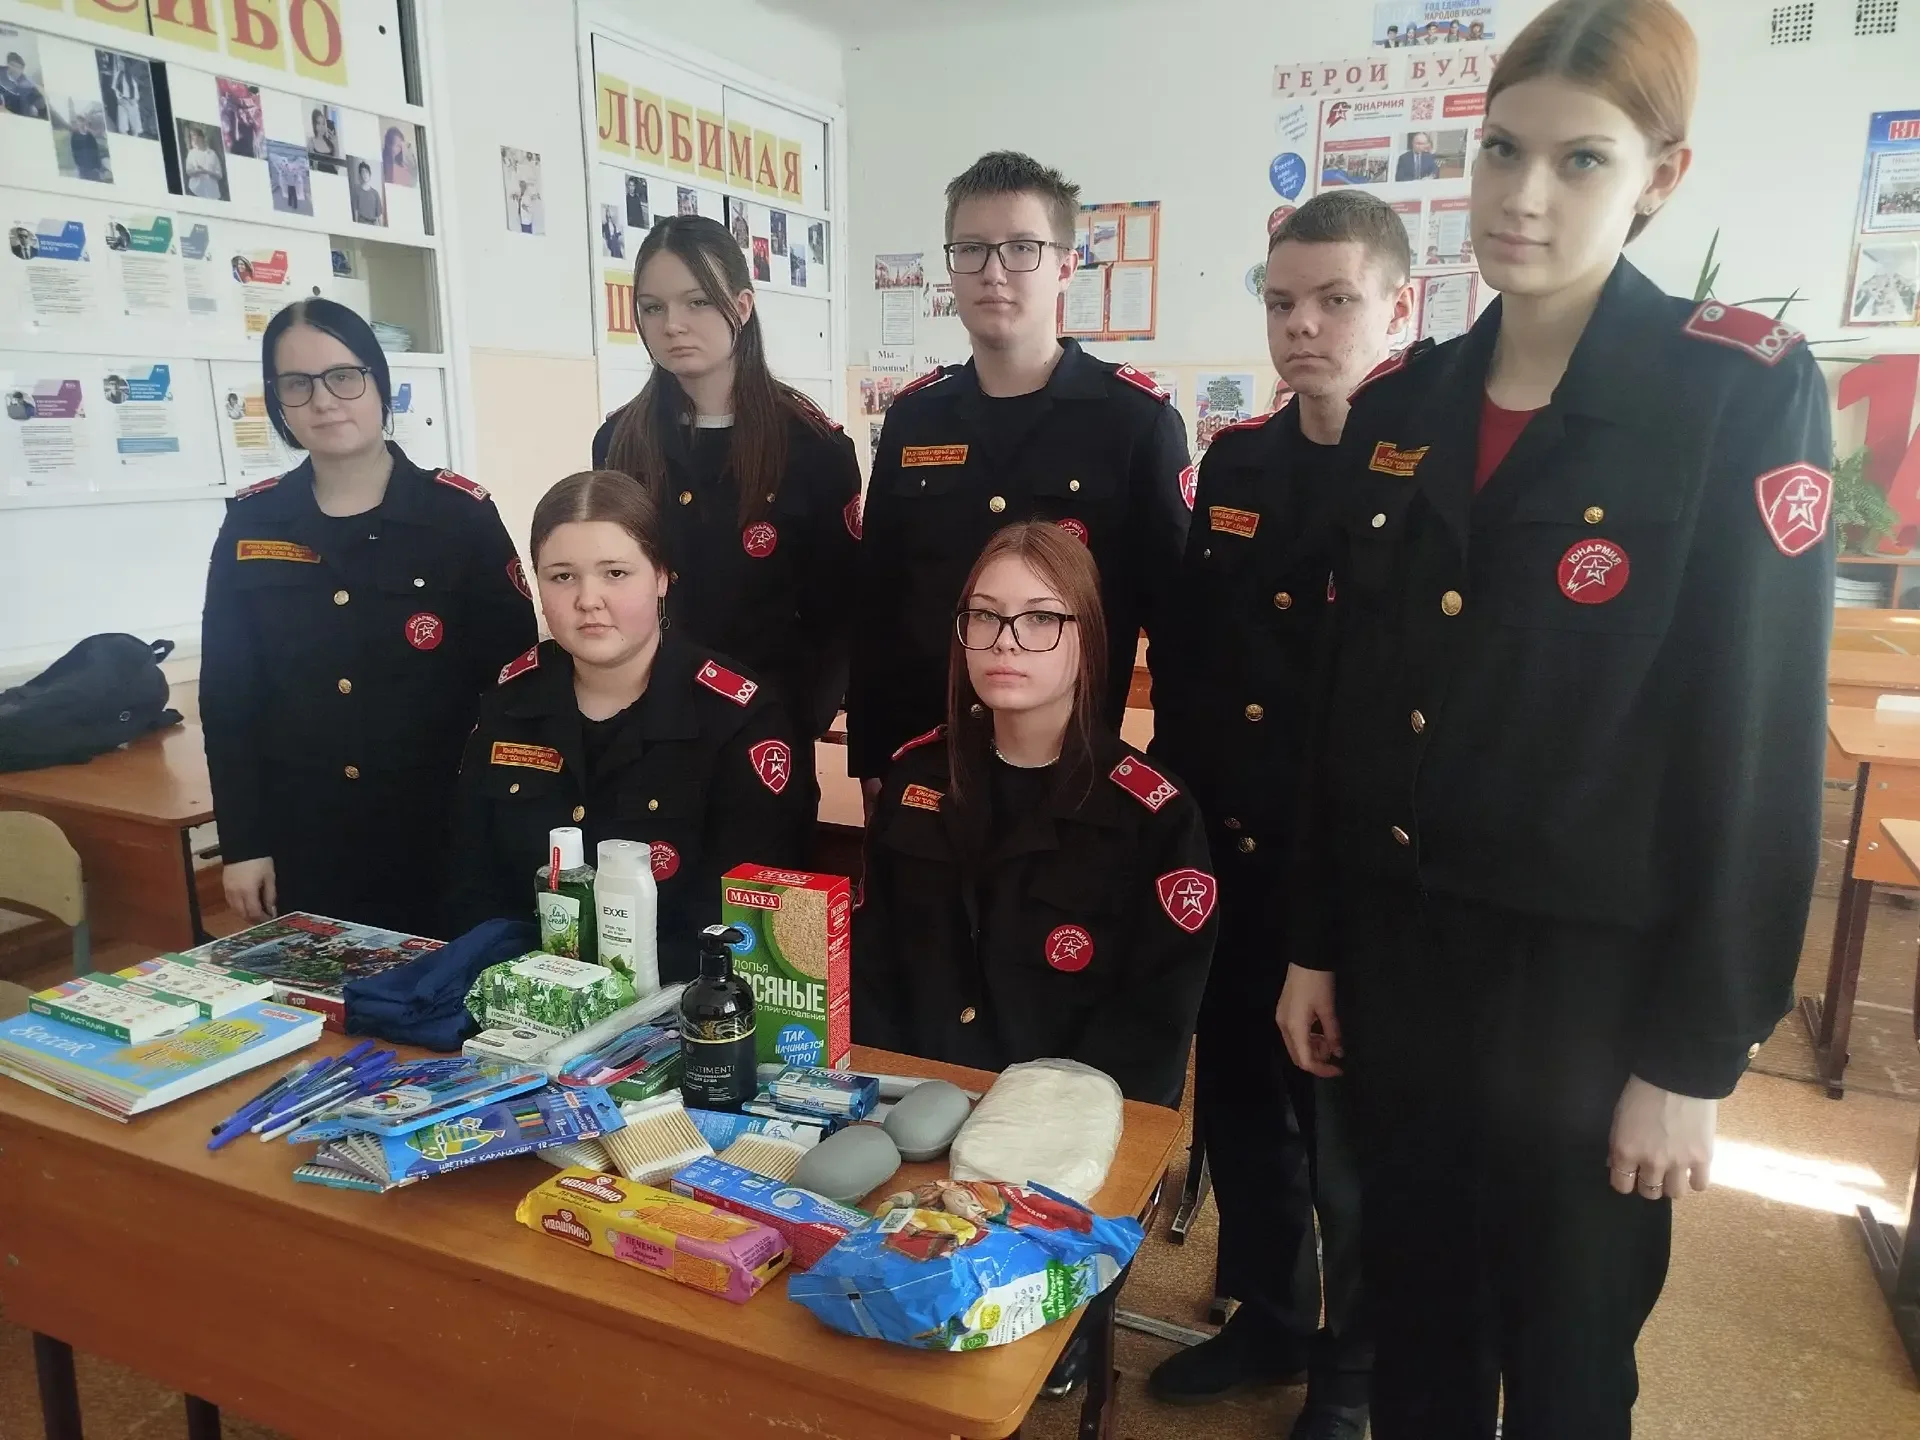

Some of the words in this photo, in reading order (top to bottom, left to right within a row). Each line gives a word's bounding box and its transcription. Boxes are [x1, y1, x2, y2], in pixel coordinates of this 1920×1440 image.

[1424, 10, 1459, 20] НАРОДОВ
[1462, 8, 1491, 17] РОССИИ
[1278, 63, 1388, 89] ГЕРОИ
[1354, 99, 1404, 112] ЮНАРМИЯ
[599, 88, 800, 194] ЛЮБИМАЯ
[872, 365, 909, 373] помним!
[1567, 544, 1622, 566] ЮНАРМИЯ
[409, 615, 439, 629] ЮНАРМИЯ
[730, 890, 778, 908] MAKFA
[602, 905, 629, 919] EXXE
[1052, 928, 1090, 947] ЮНАРМИЯ
[732, 959, 770, 974] ЛОПЬЯ
[291, 997, 306, 1005] 100
[60, 1011, 106, 1032] ПЛАСТИЛИН
[764, 1005, 826, 1022] ПРИГОТОВЛЕНИЯ
[782, 1030, 806, 1041] ТАК
[775, 1039, 824, 1055] НАЧИНАЕТСЯ
[784, 1050, 817, 1064] УТРО!
[802, 1099, 825, 1108] Absolut
[439, 1156, 477, 1172] ЦВЕТНЫЕ
[538, 1141, 548, 1149] 12
[560, 1177, 622, 1202] ИВАШКИНО
[543, 1217, 591, 1242] ИВАШКИНО
[625, 1236, 664, 1256] ПЕЧЕНЬЕ
